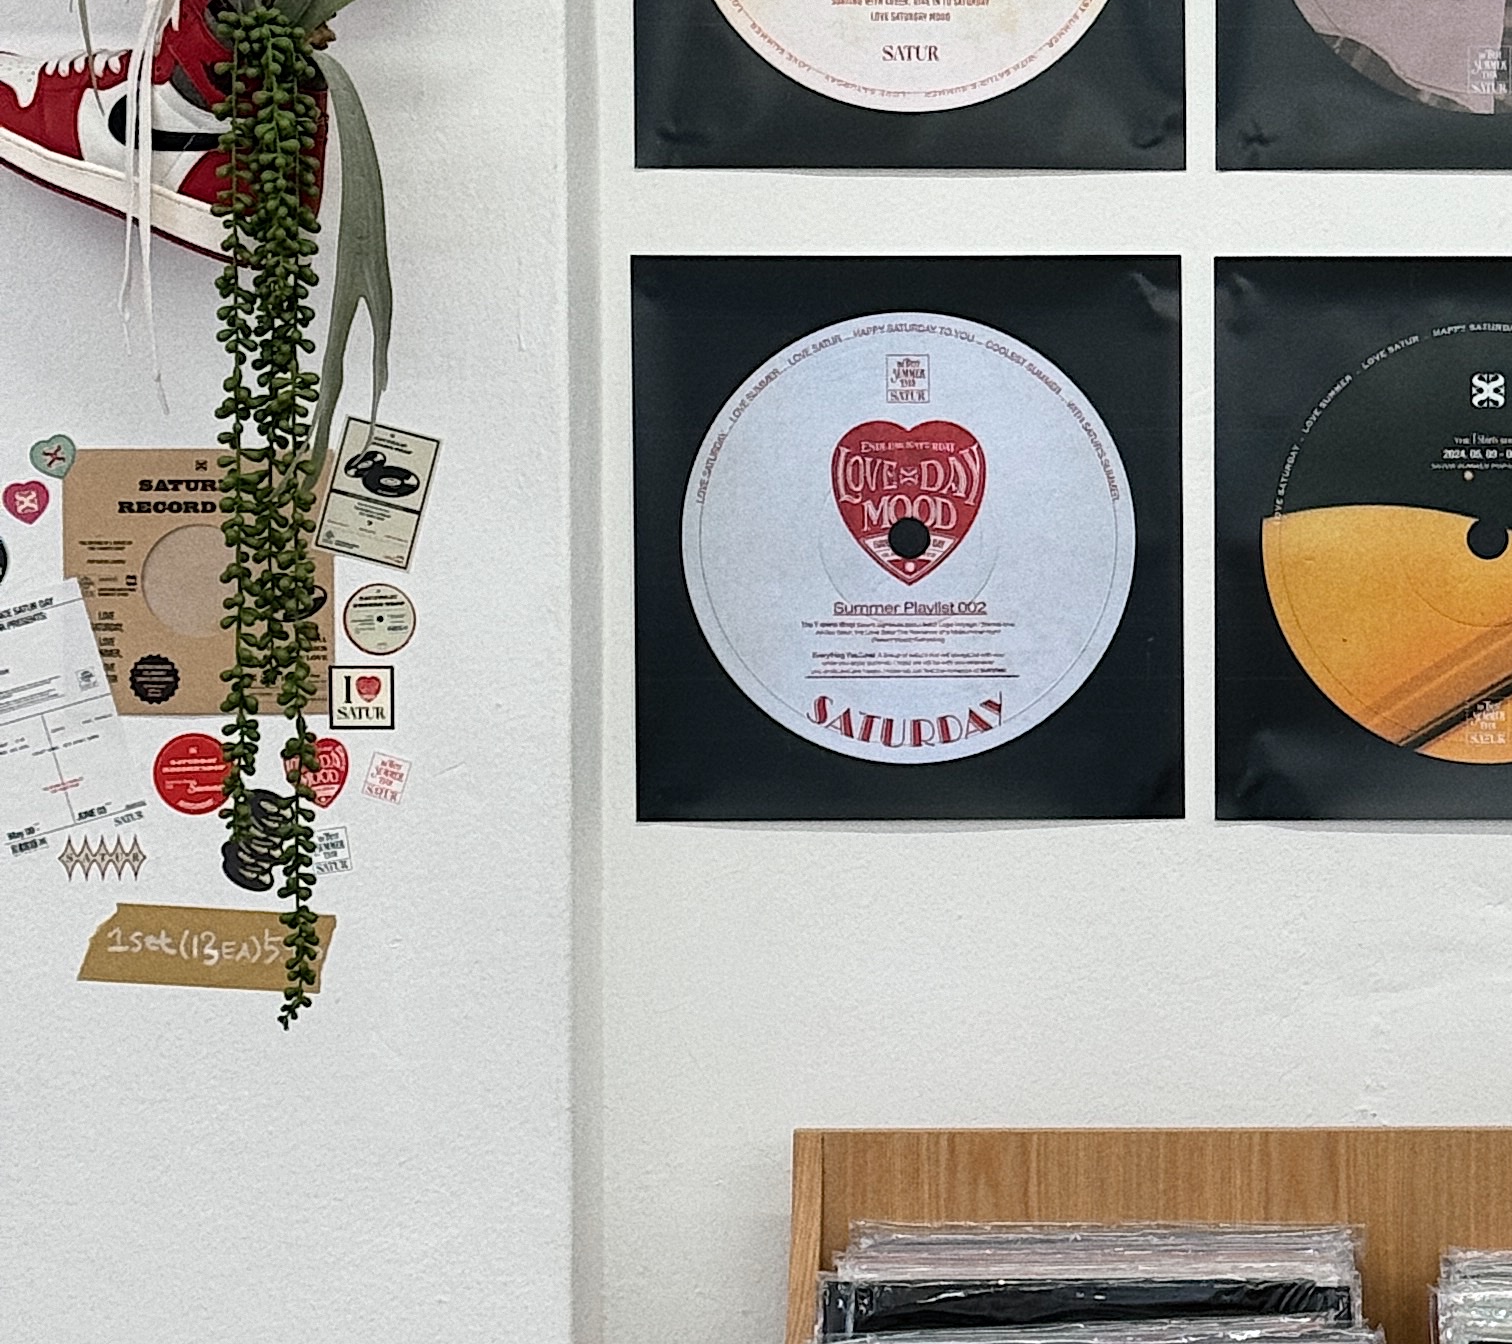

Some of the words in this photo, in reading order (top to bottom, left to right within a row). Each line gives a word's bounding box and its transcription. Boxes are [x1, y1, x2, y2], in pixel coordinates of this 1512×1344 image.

[881, 44, 940, 62] SATUR
[1361, 348, 1388, 371] LOVE
[1386, 334, 1421, 357] SATUR
[1301, 407, 1321, 435] LOVE
[1318, 373, 1353, 410] SUMMER
[138, 479, 221, 493] SATUR
[836, 445, 898, 504] LOVE
[918, 442, 983, 506] DAY
[117, 500, 217, 514] RECORD
[861, 492, 958, 533] MOOD
[833, 601, 901, 615] Summer
[904, 601, 957, 616] Playlist
[957, 601, 988, 614] 002
[343, 675, 352, 705] I
[336, 705, 386, 721] SATUR
[805, 689, 1005, 749] SATURDAY
